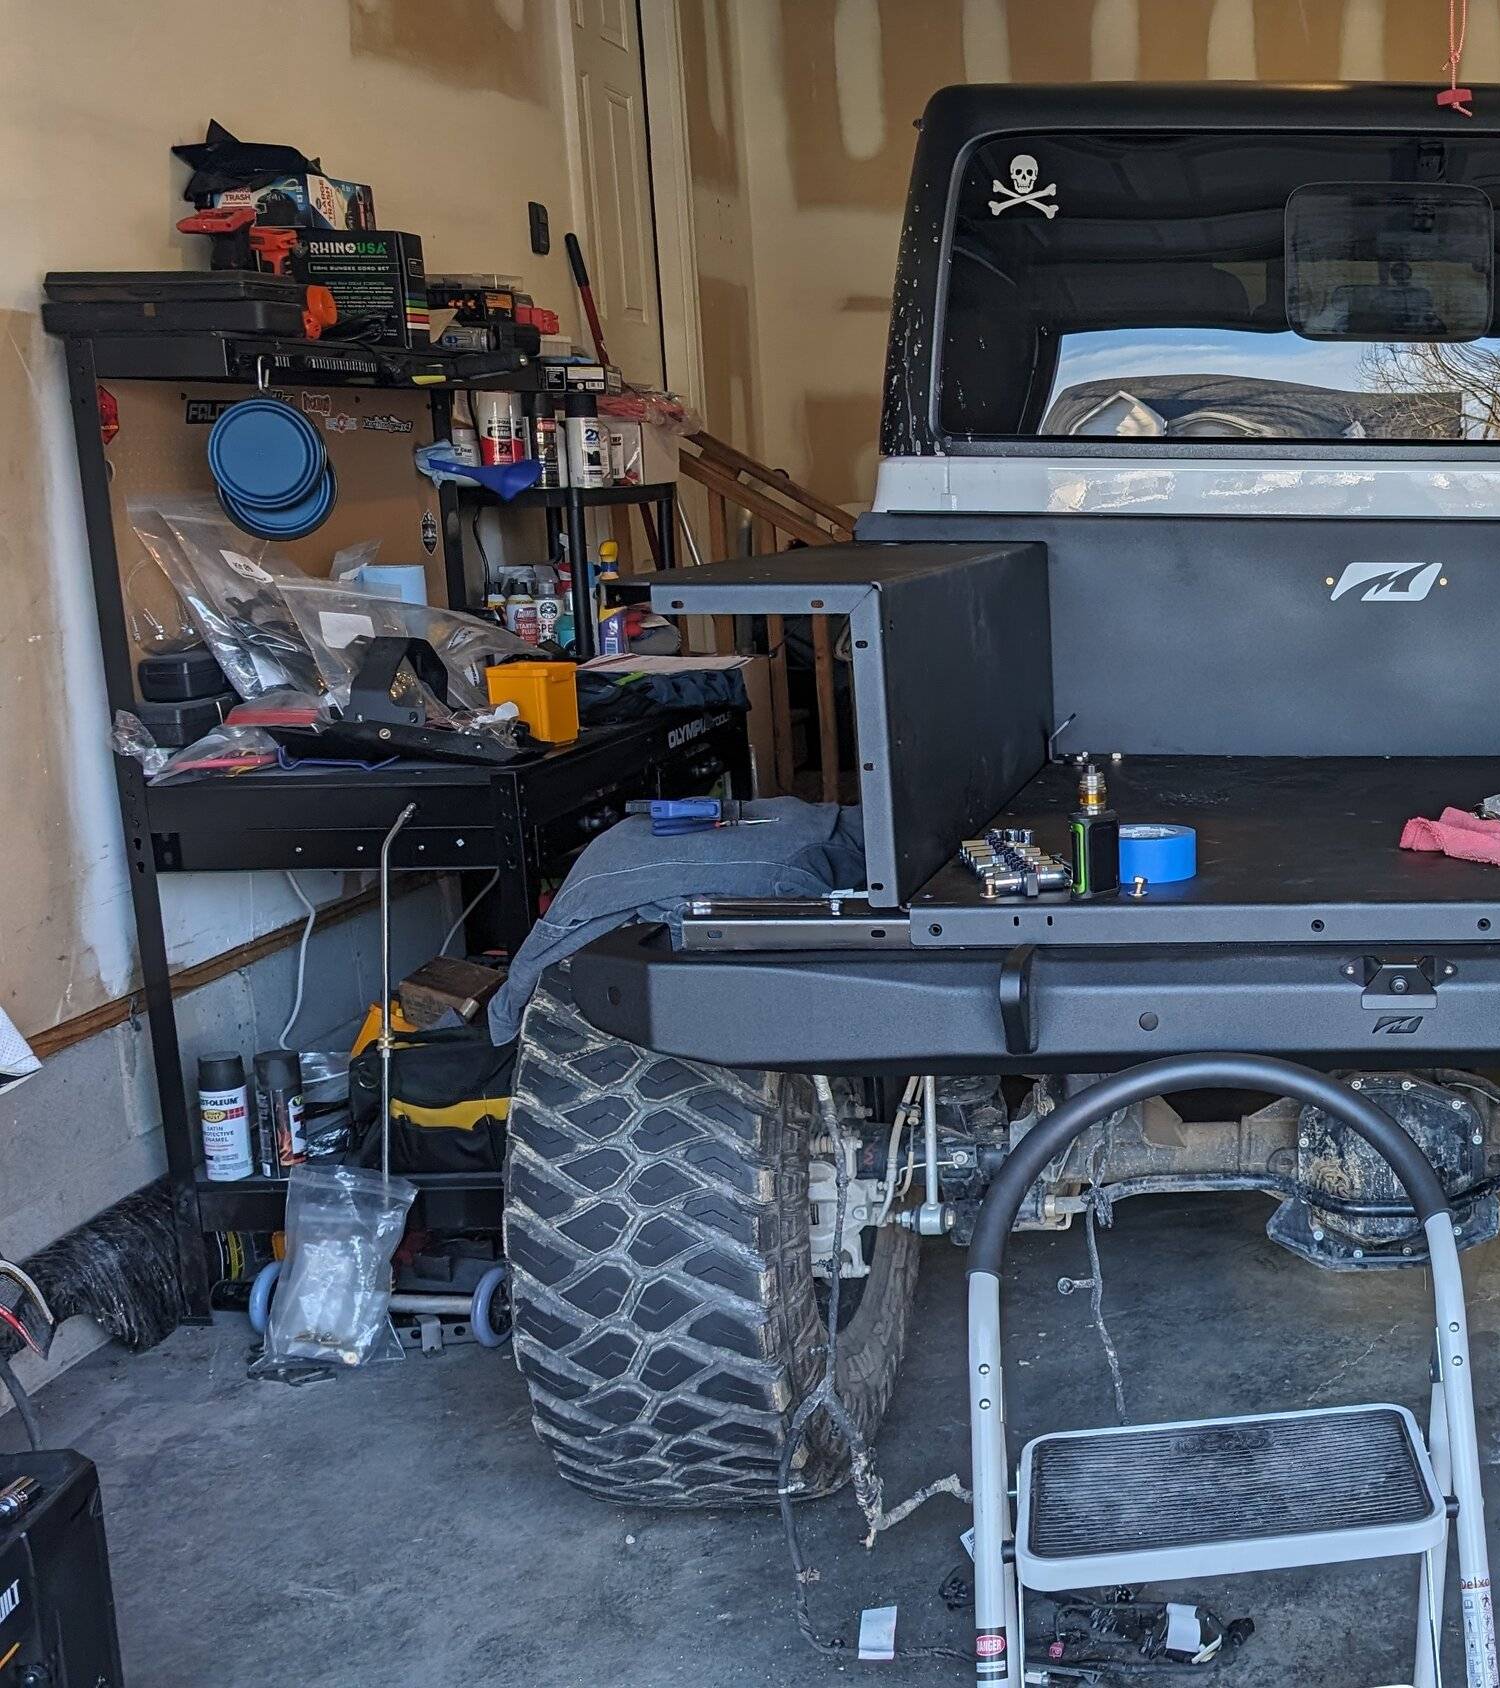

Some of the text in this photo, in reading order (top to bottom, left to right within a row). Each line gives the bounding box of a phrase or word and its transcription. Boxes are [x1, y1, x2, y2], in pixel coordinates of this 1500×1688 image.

[225, 194, 251, 202] TRASH
[188, 403, 226, 422] FALC
[667, 718, 708, 749] OLYMPI
